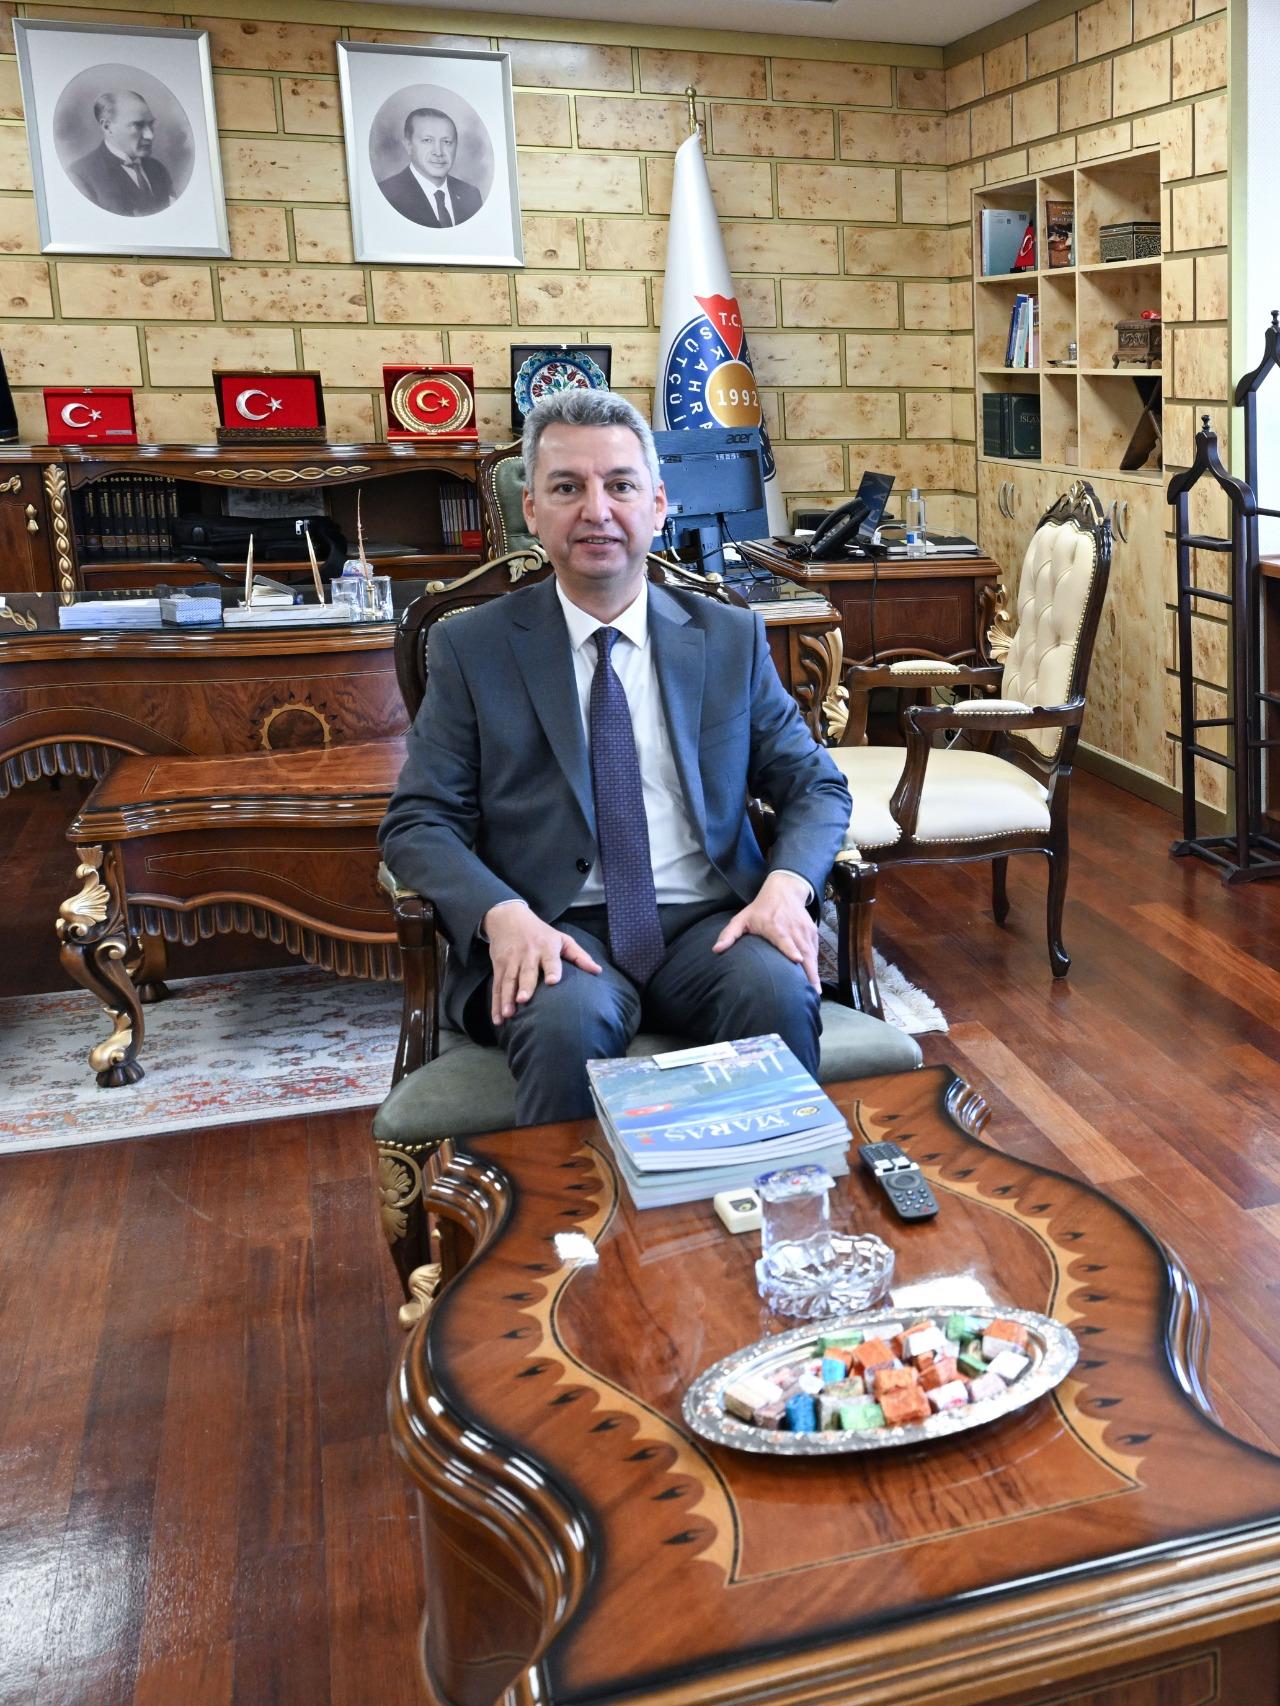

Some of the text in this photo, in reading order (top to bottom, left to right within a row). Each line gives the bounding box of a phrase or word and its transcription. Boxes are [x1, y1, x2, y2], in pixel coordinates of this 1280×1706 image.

[719, 313, 741, 327] T.C.
[716, 389, 759, 406] 1992
[726, 432, 753, 444] acer
